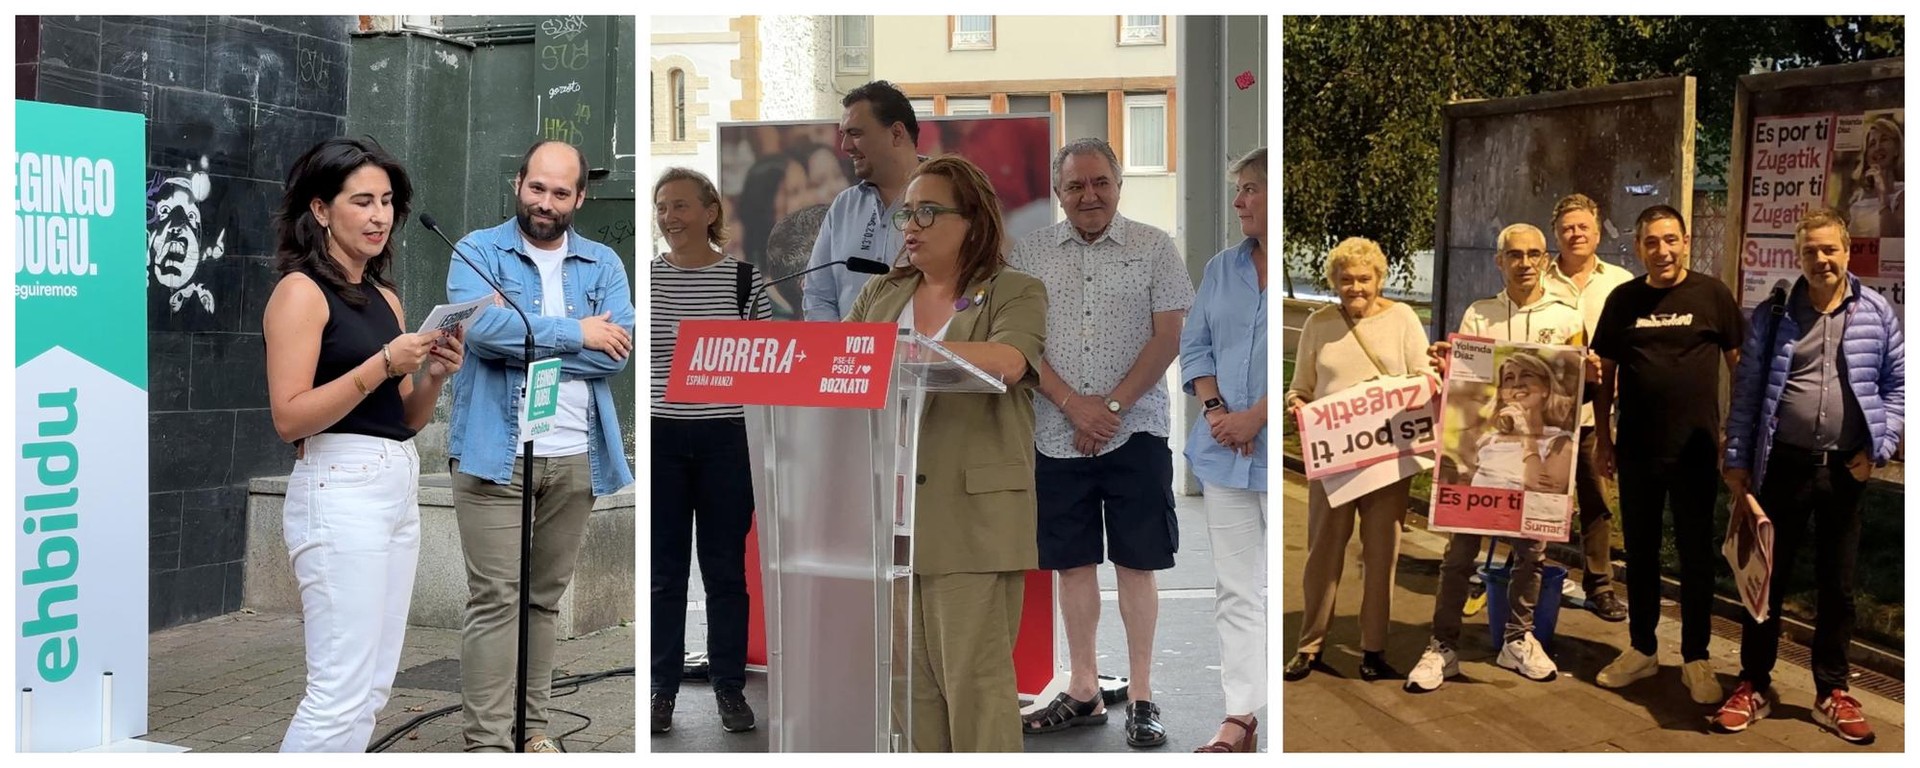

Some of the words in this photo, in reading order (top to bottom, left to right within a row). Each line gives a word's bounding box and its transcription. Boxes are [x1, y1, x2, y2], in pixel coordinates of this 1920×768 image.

[1756, 123, 1774, 143] Es
[1778, 124, 1810, 147] por
[1815, 118, 1829, 140] ti
[1756, 147, 1821, 174] Zugatik
[1752, 176, 1770, 197] Es
[1773, 180, 1804, 201] por
[1809, 175, 1823, 196] ti
[1744, 240, 1801, 270] Suma
[689, 337, 797, 374] AURRERA
[845, 336, 875, 354] VOTA
[1455, 341, 1492, 354] Yolanda
[831, 364, 855, 374] PSOE
[833, 356, 856, 364] PSE-EE
[686, 374, 709, 386] ESPAÑA
[709, 375, 734, 387] AVANZA
[819, 377, 869, 394] BOZKATU
[1311, 384, 1421, 431] Zugatik
[1342, 418, 1394, 454] por
[1400, 416, 1435, 444] Es
[1311, 440, 1335, 468] ti
[1438, 487, 1461, 506] Es
[1466, 492, 1502, 511] por
[1507, 493, 1522, 511] ti
[22, 387, 79, 683] ehbildu
[1524, 520, 1562, 535] Sumar
